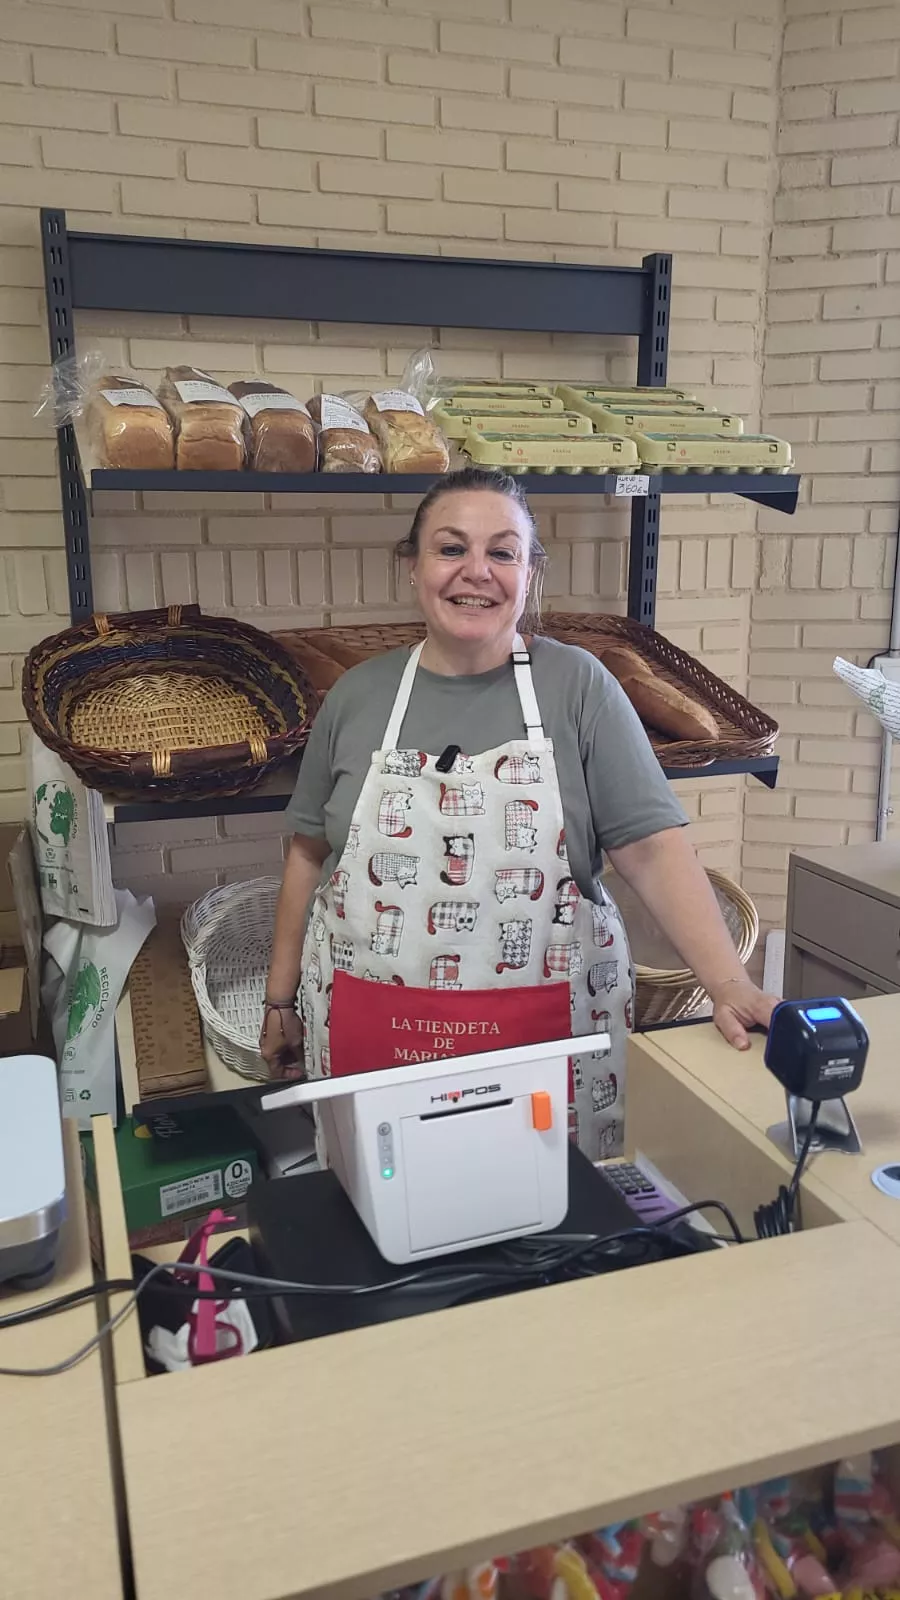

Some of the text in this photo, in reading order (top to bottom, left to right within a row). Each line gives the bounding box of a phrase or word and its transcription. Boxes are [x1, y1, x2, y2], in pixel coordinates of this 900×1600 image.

[91, 966, 110, 1029] RECICLADO
[391, 1016, 501, 1035] LA TIENDETA
[432, 1036, 455, 1050] DE
